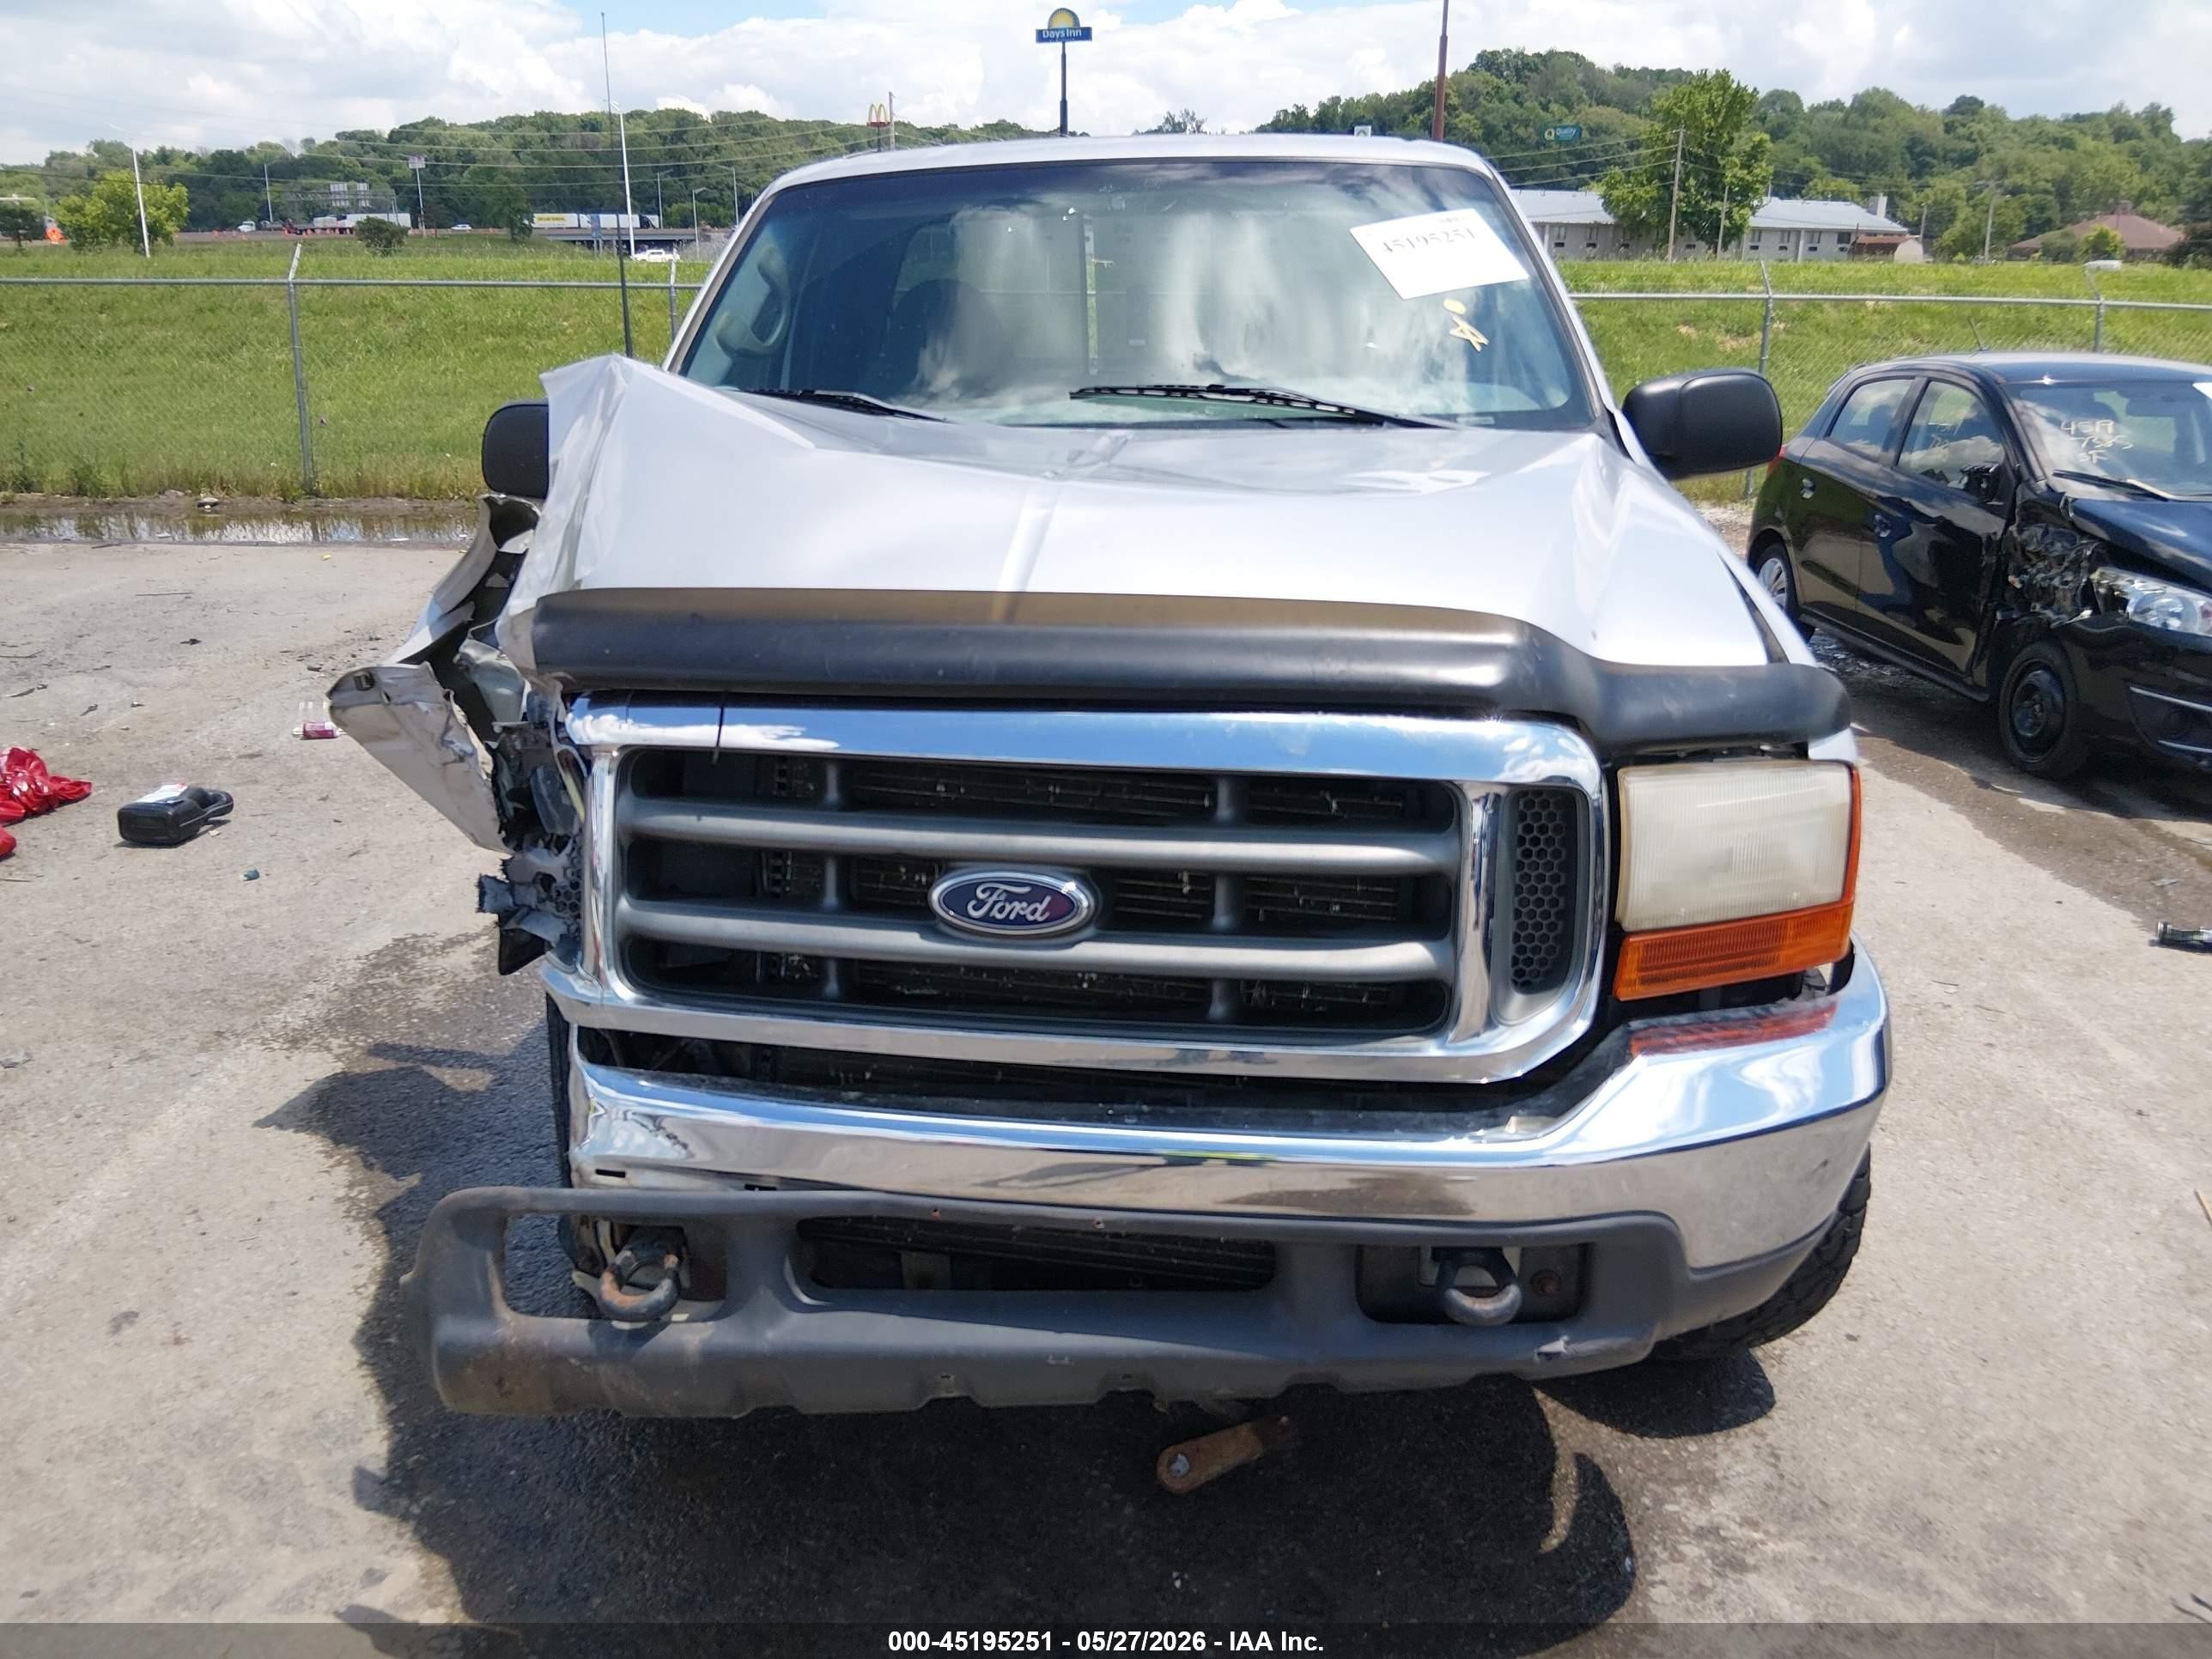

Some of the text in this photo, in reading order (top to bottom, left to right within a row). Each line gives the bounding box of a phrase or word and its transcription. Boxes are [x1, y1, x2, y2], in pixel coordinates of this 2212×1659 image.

[1042, 27, 1082, 39] Days Inn
[967, 882, 1053, 922] Ford
